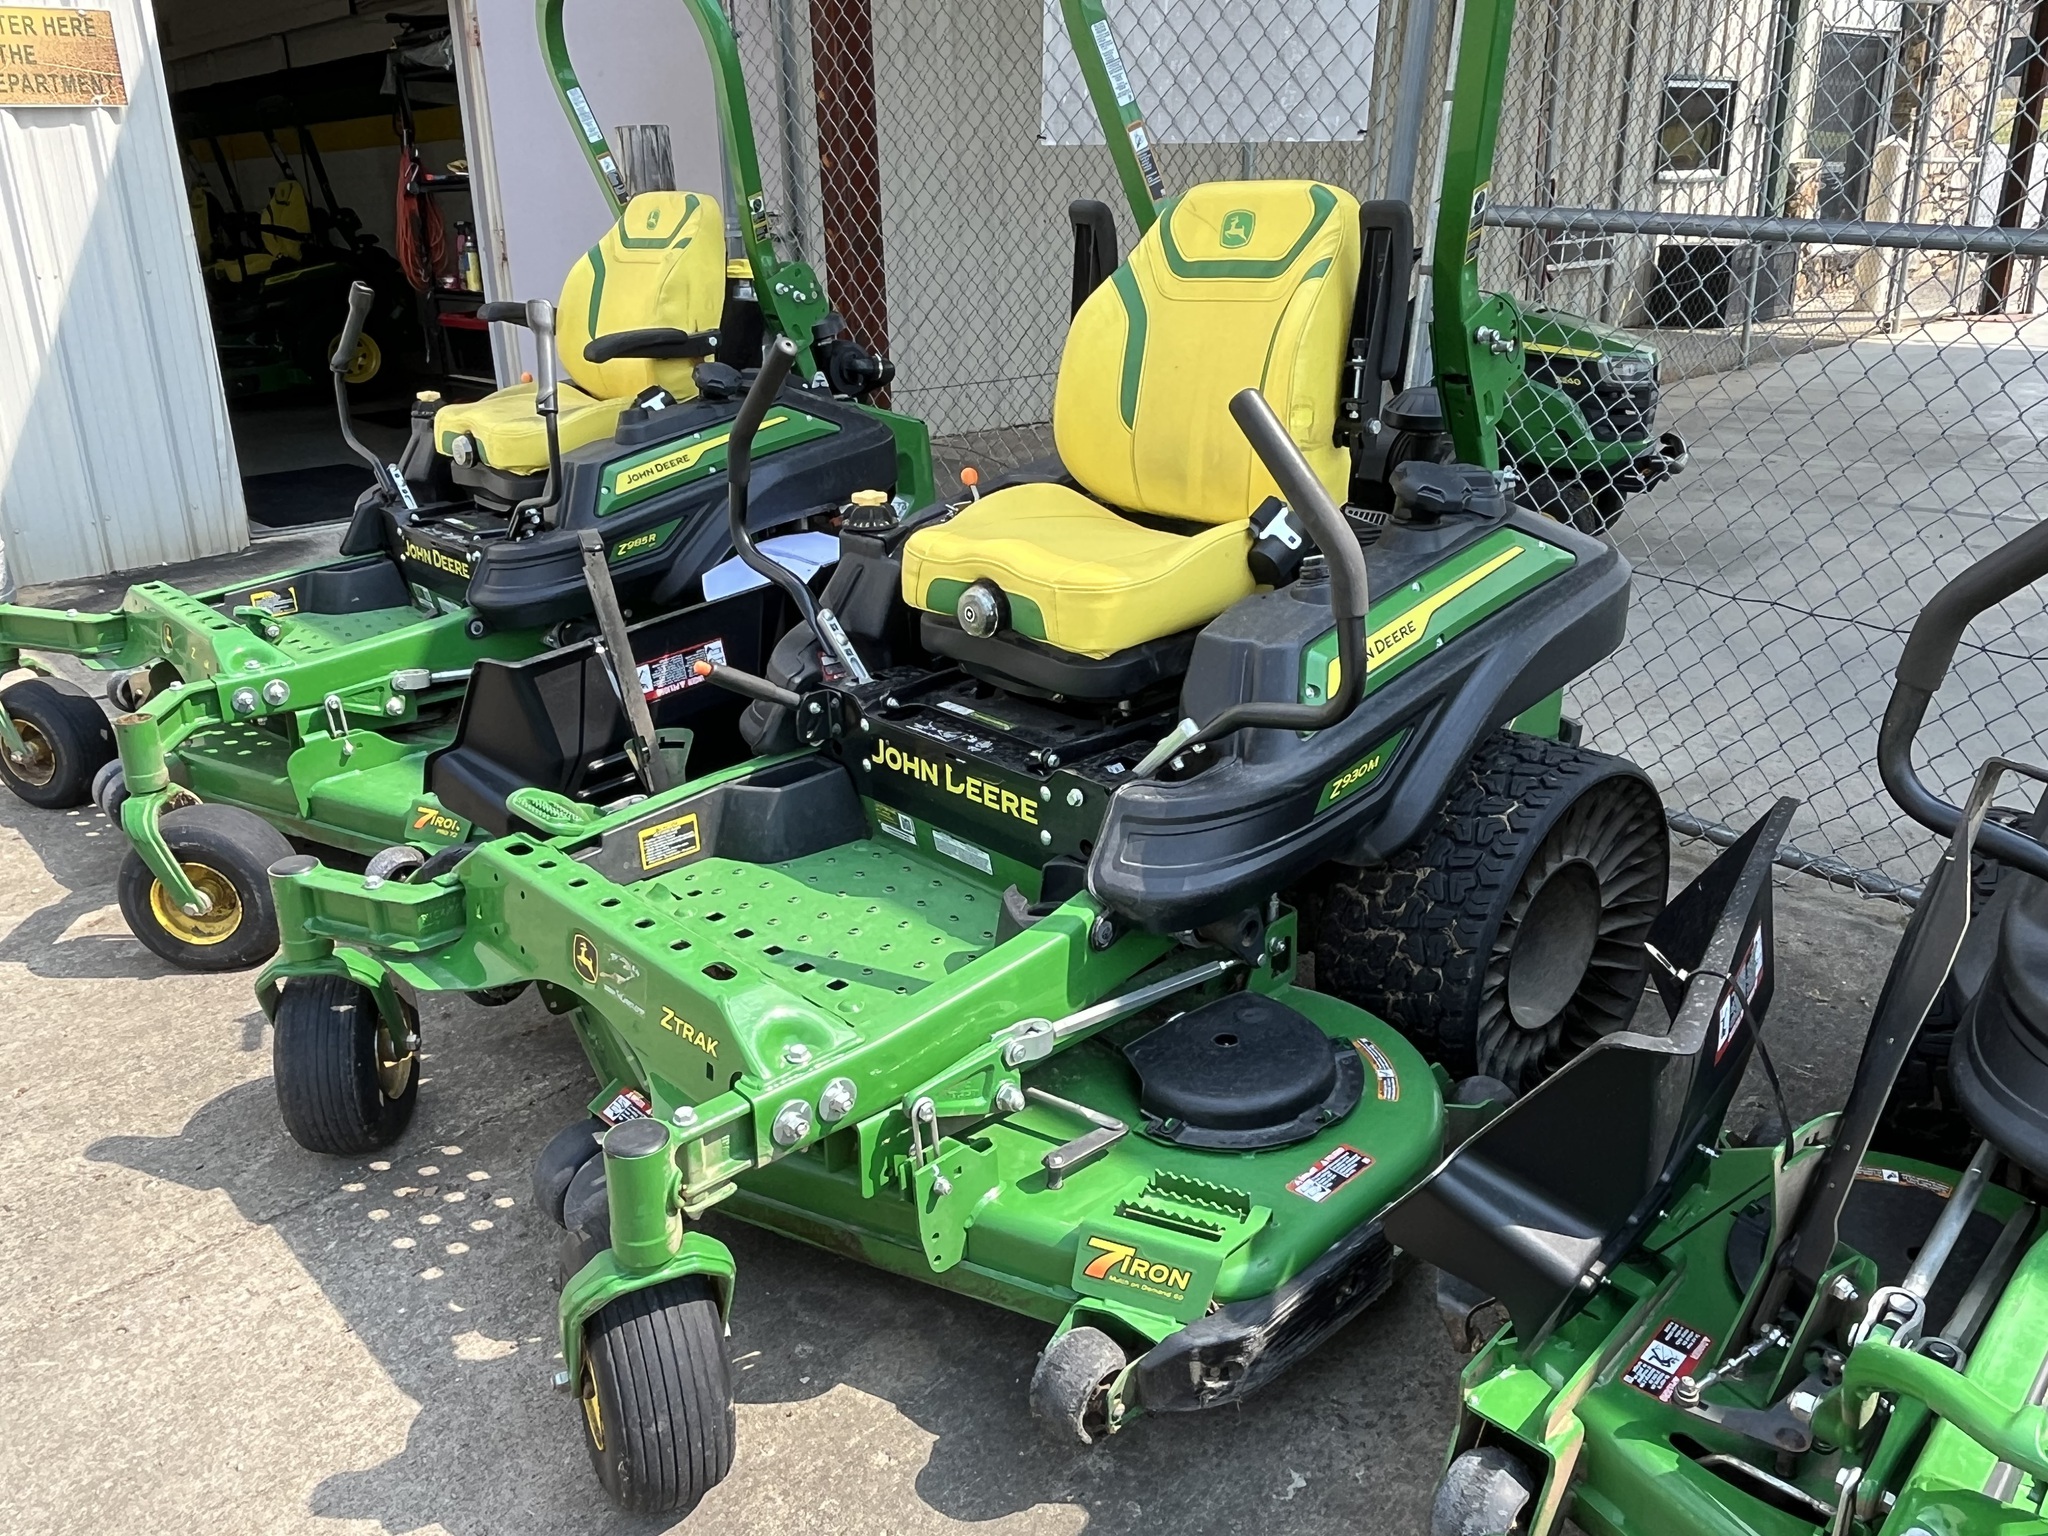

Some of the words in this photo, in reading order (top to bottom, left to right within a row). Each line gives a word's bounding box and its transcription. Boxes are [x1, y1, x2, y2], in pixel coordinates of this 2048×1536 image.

[42, 16, 97, 37] HERE
[627, 467, 655, 485] JOHN
[655, 454, 690, 473] DEERE
[405, 539, 432, 565] JOHN
[432, 549, 470, 579] DEERE
[1374, 620, 1416, 655] DEERE
[871, 738, 938, 786] JOHN
[1329, 755, 1380, 800] Z930M
[659, 1005, 719, 1058] ZTRAK
[1130, 1281, 1140, 1289] on
[1141, 1283, 1172, 1298] Demand
